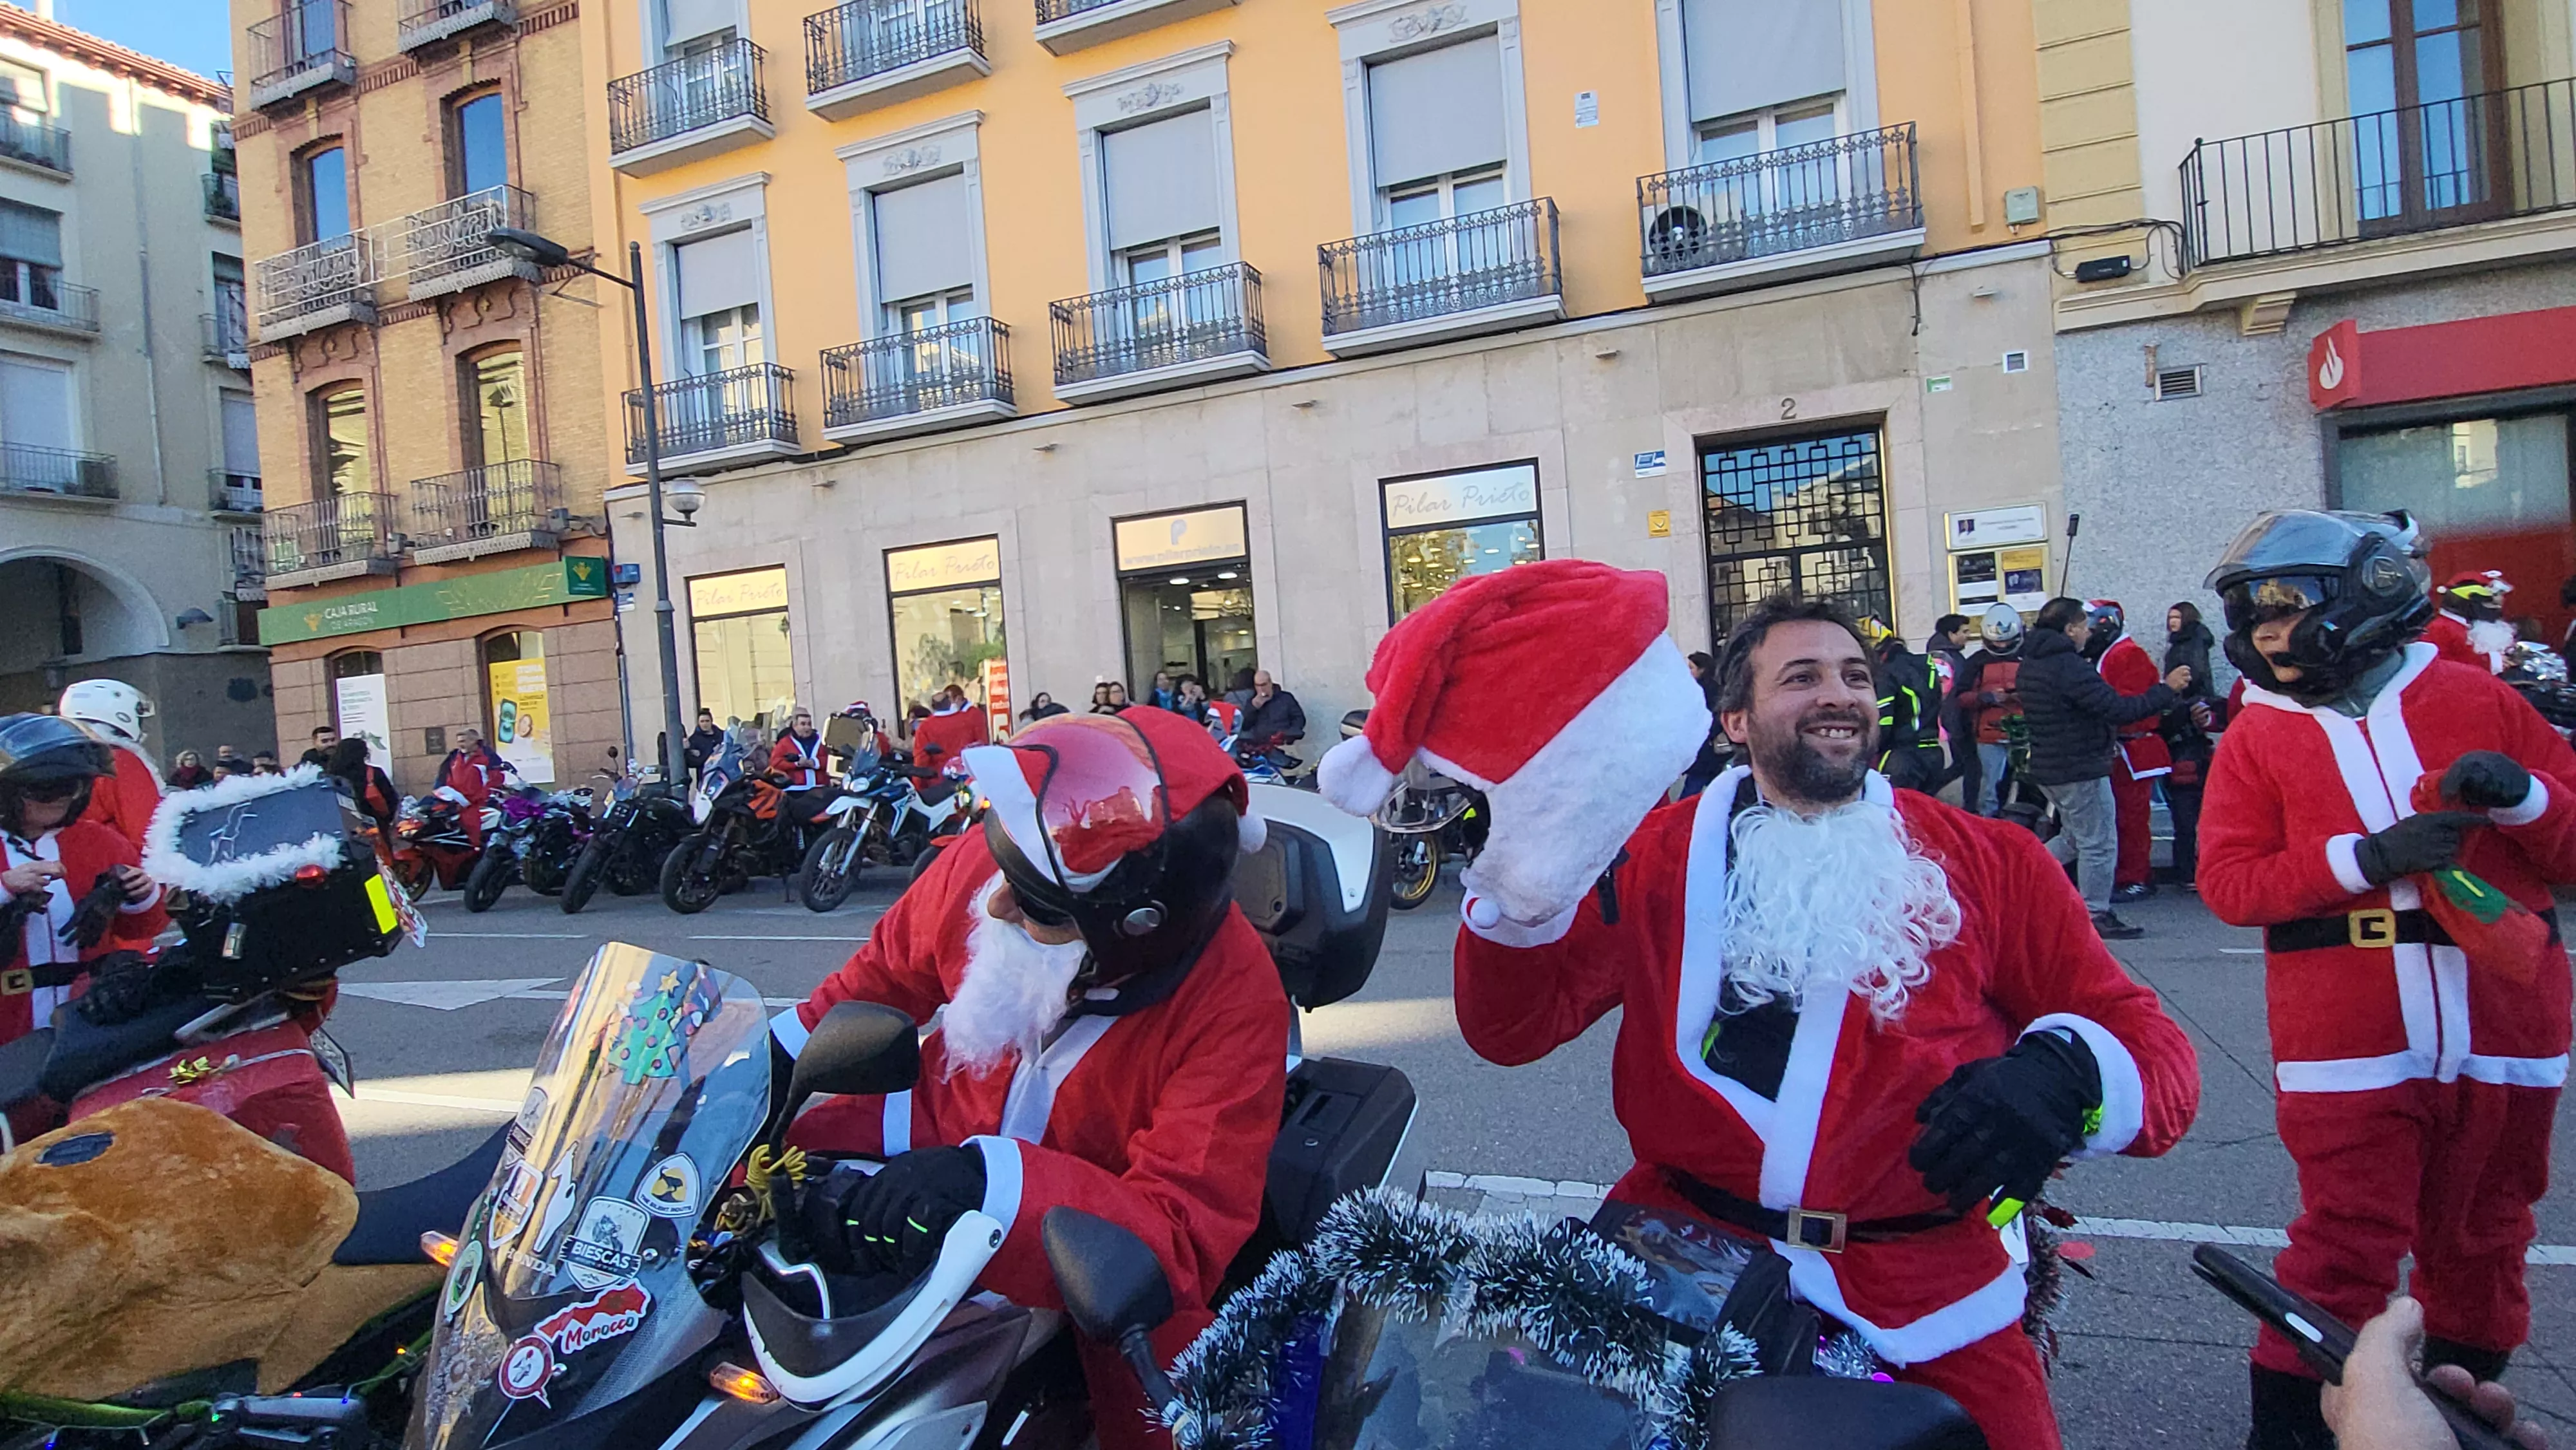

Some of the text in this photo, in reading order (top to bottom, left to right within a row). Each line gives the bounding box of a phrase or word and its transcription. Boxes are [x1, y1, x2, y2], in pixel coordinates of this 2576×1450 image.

[1781, 397, 1797, 420] 2
[1392, 482, 1530, 517] Pilar Prieto
[895, 554, 995, 581] Pilar Prieto
[696, 582, 783, 608] Pilar Prieto
[506, 1248, 556, 1277] HONDA
[571, 1241, 631, 1269] BIESCAS
[565, 1317, 634, 1350] Morocco
